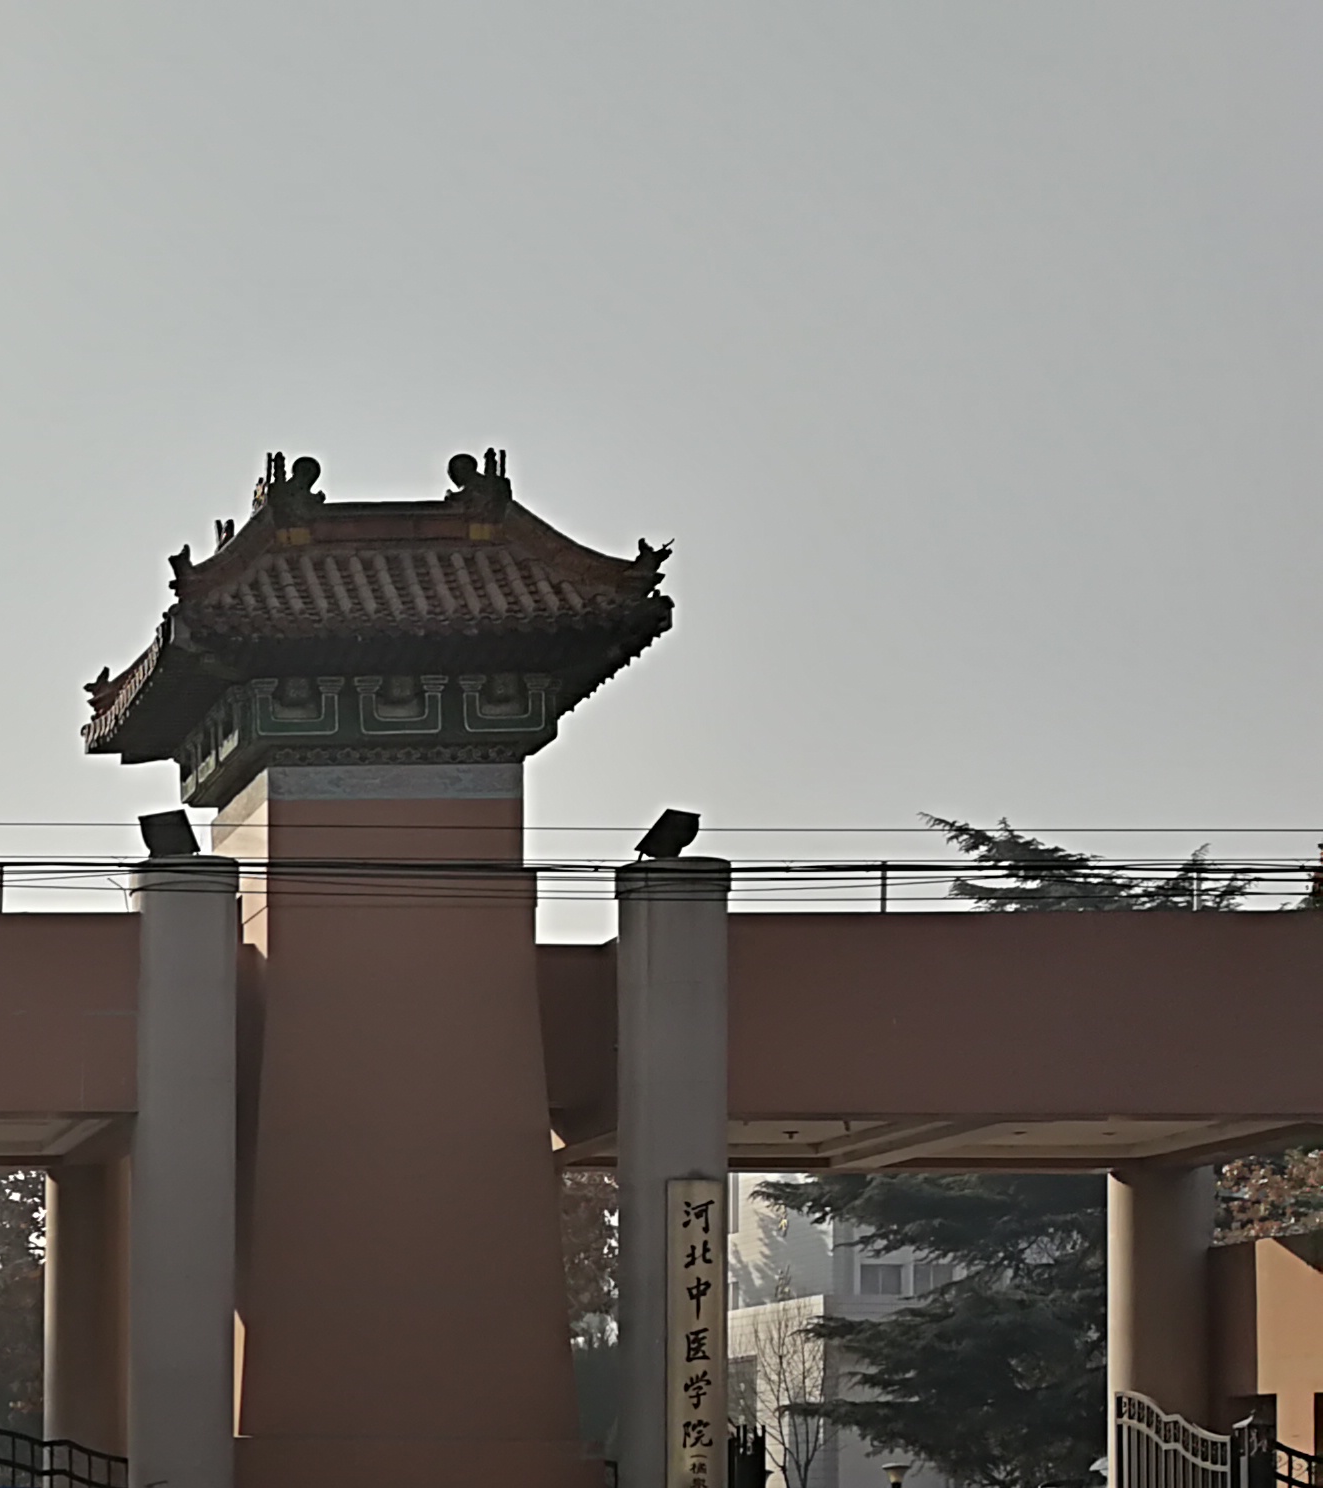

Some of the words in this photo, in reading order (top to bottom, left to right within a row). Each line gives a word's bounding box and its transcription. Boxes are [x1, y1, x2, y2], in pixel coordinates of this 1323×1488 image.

[681, 1199, 716, 1449] 河北中医学院
